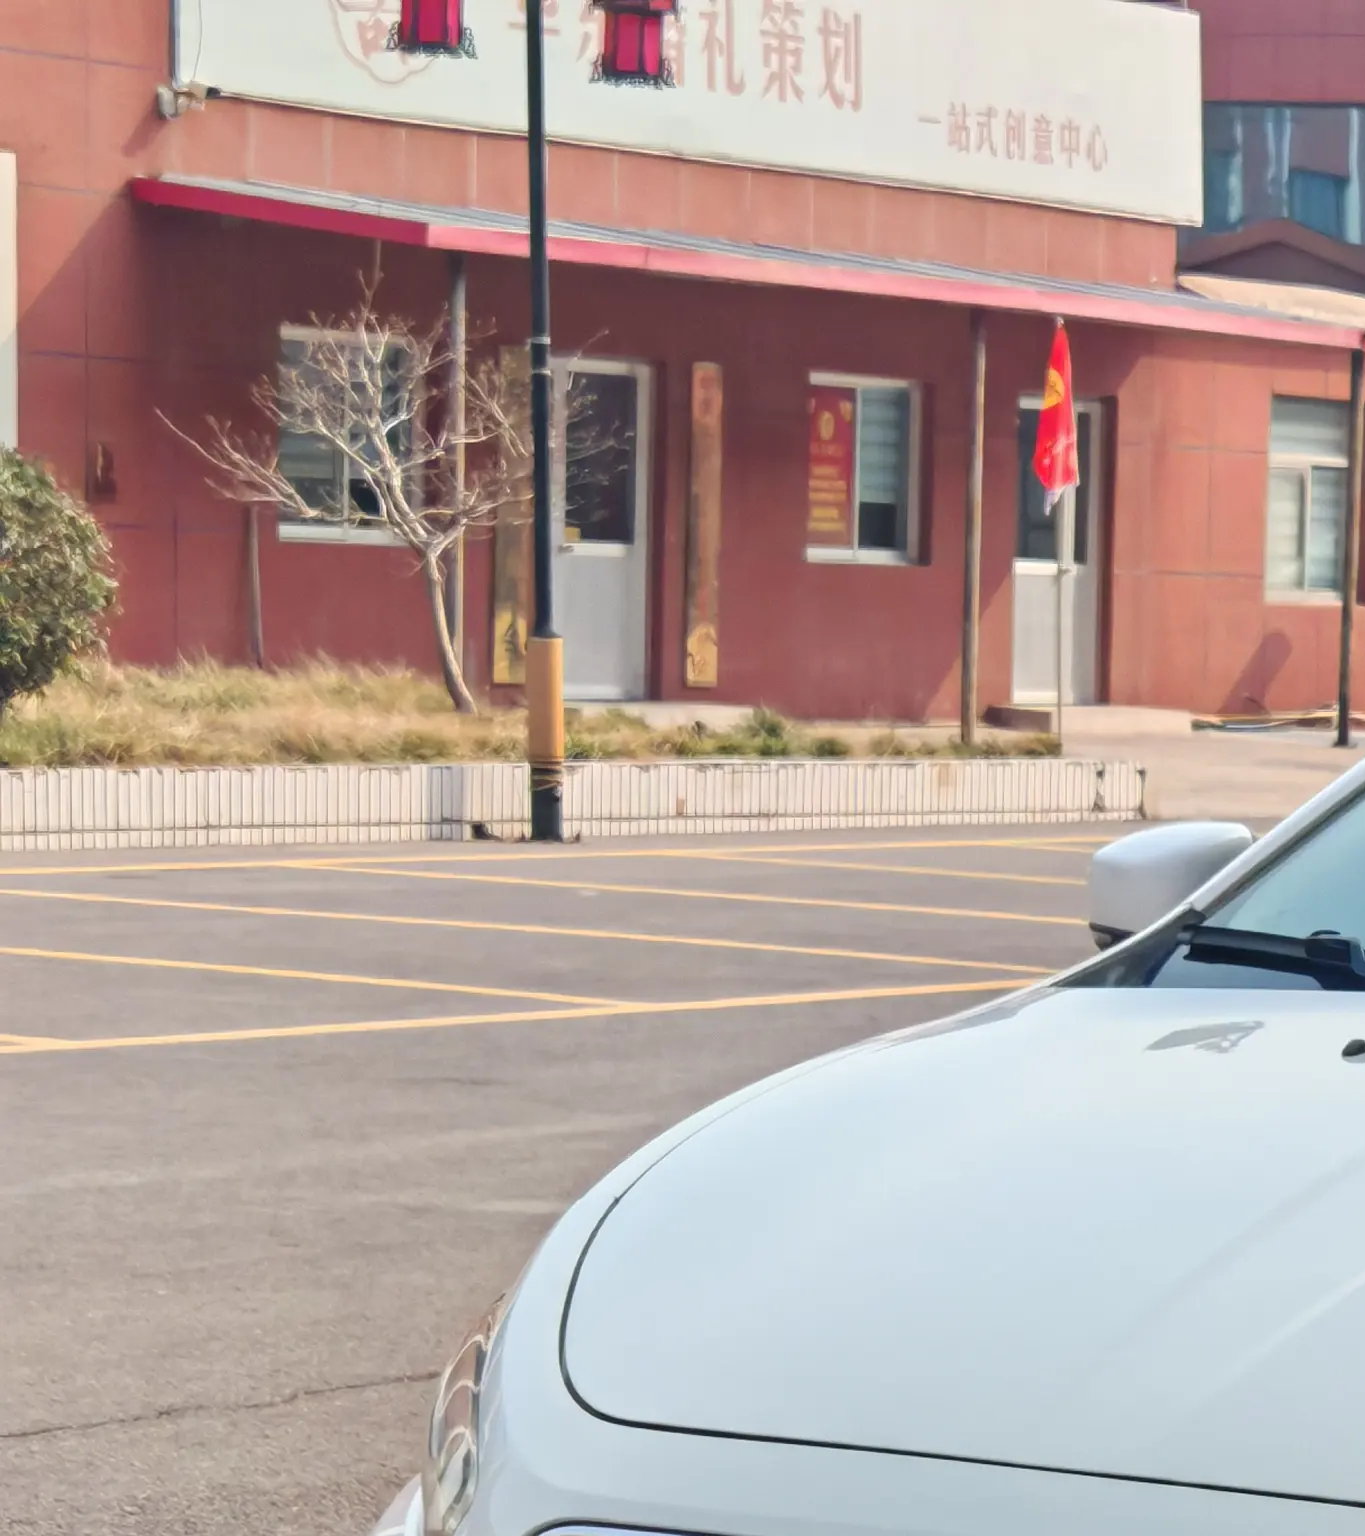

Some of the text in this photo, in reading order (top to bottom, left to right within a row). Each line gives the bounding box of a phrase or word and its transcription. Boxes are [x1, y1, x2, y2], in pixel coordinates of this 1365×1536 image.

[916, 101, 1108, 172] 一站式创意中心
